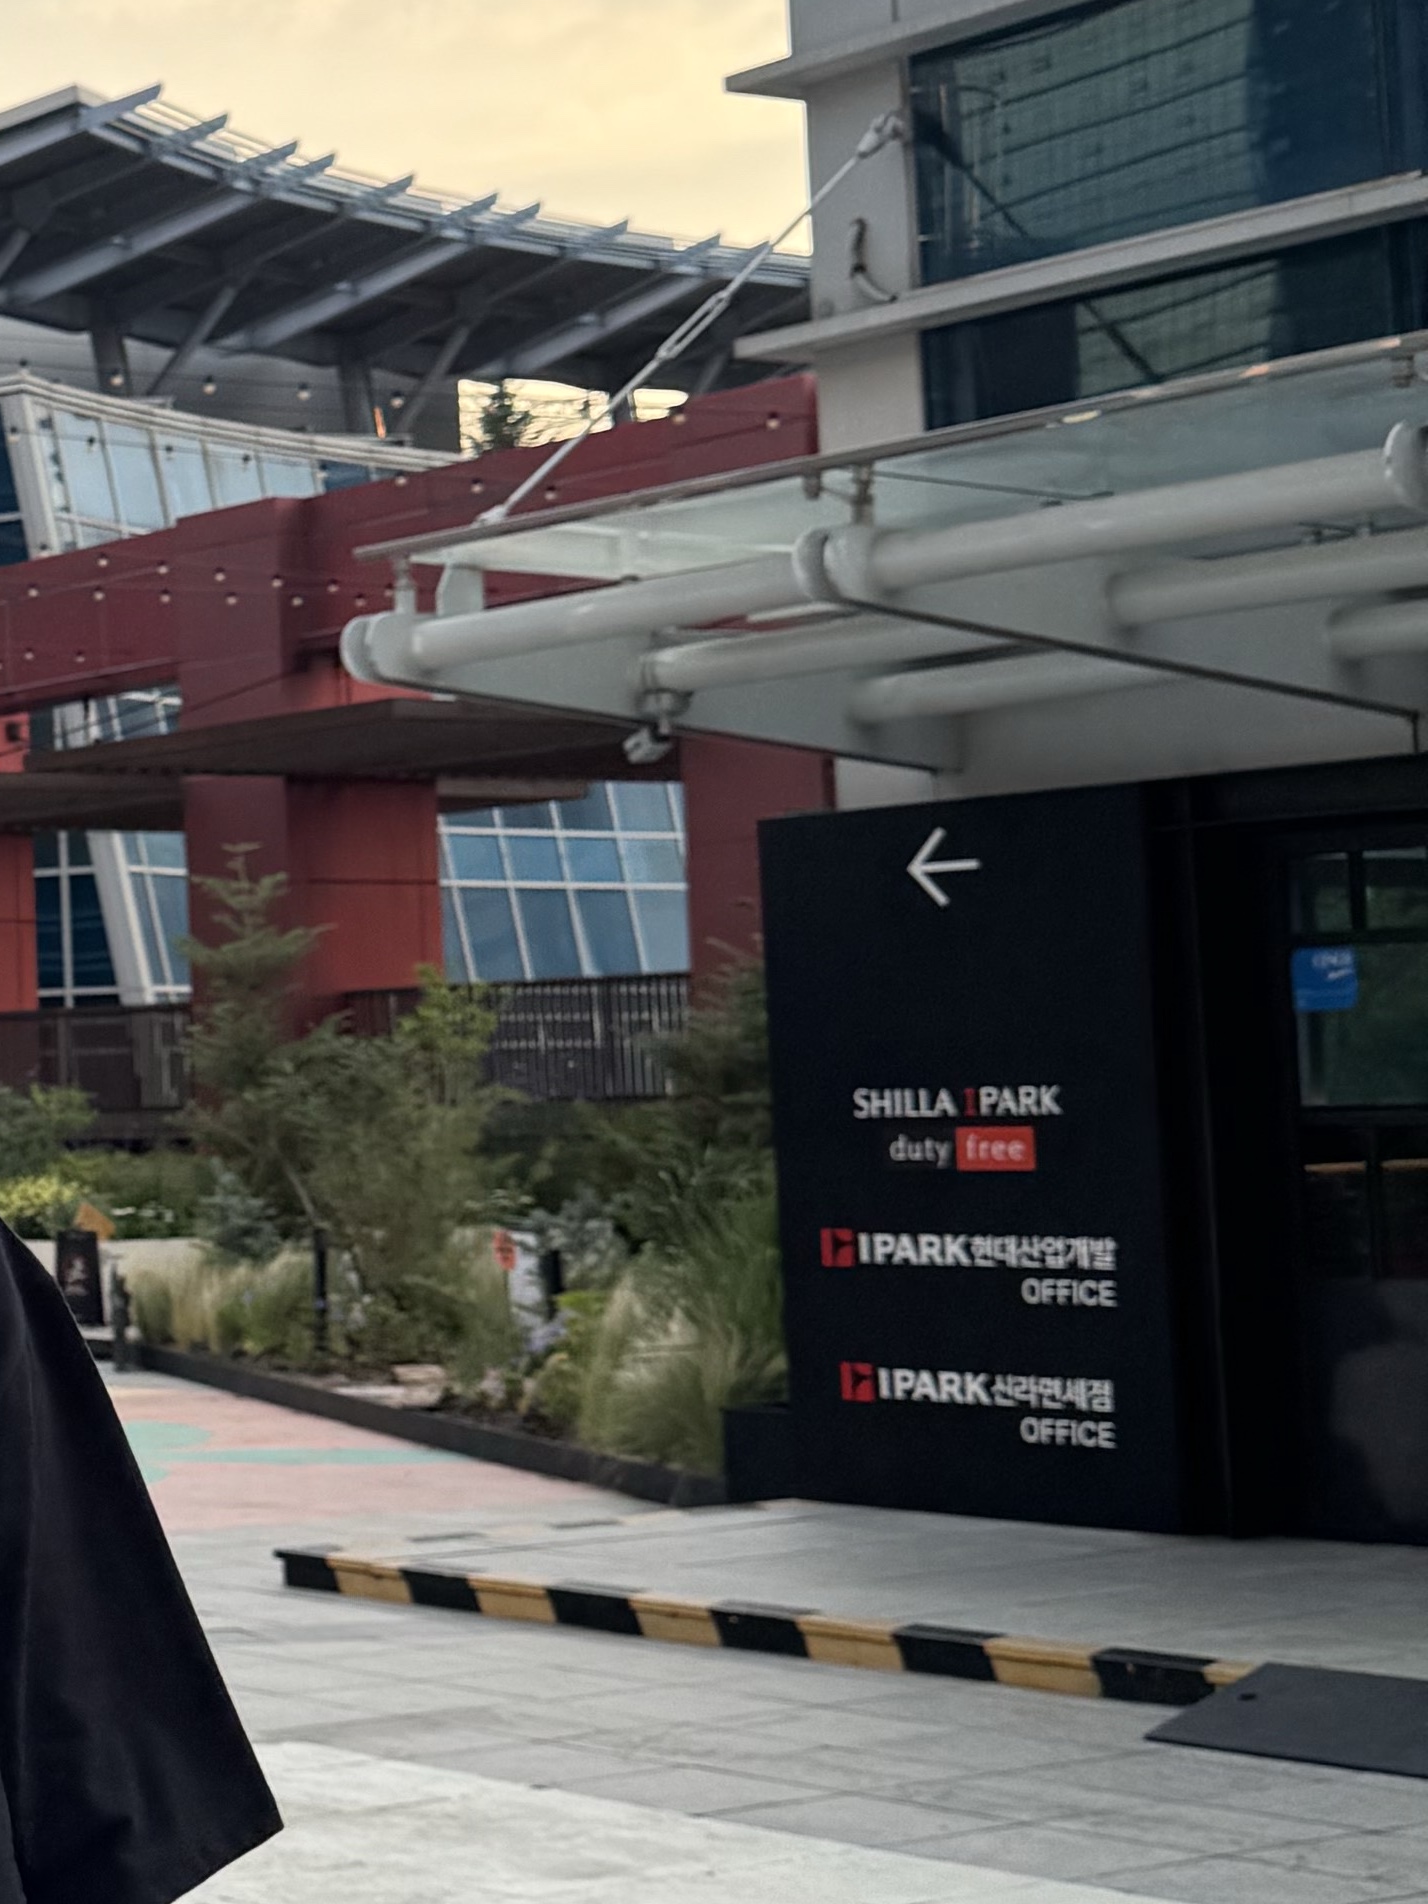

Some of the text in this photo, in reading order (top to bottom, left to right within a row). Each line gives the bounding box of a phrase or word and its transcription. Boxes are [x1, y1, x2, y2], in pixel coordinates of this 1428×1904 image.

[853, 1084, 1063, 1120] SHILLA IPARK
[889, 1133, 1026, 1169] duty free
[1020, 1276, 1118, 1308] OFFICE
[1019, 1415, 1117, 1449] OFFICE
